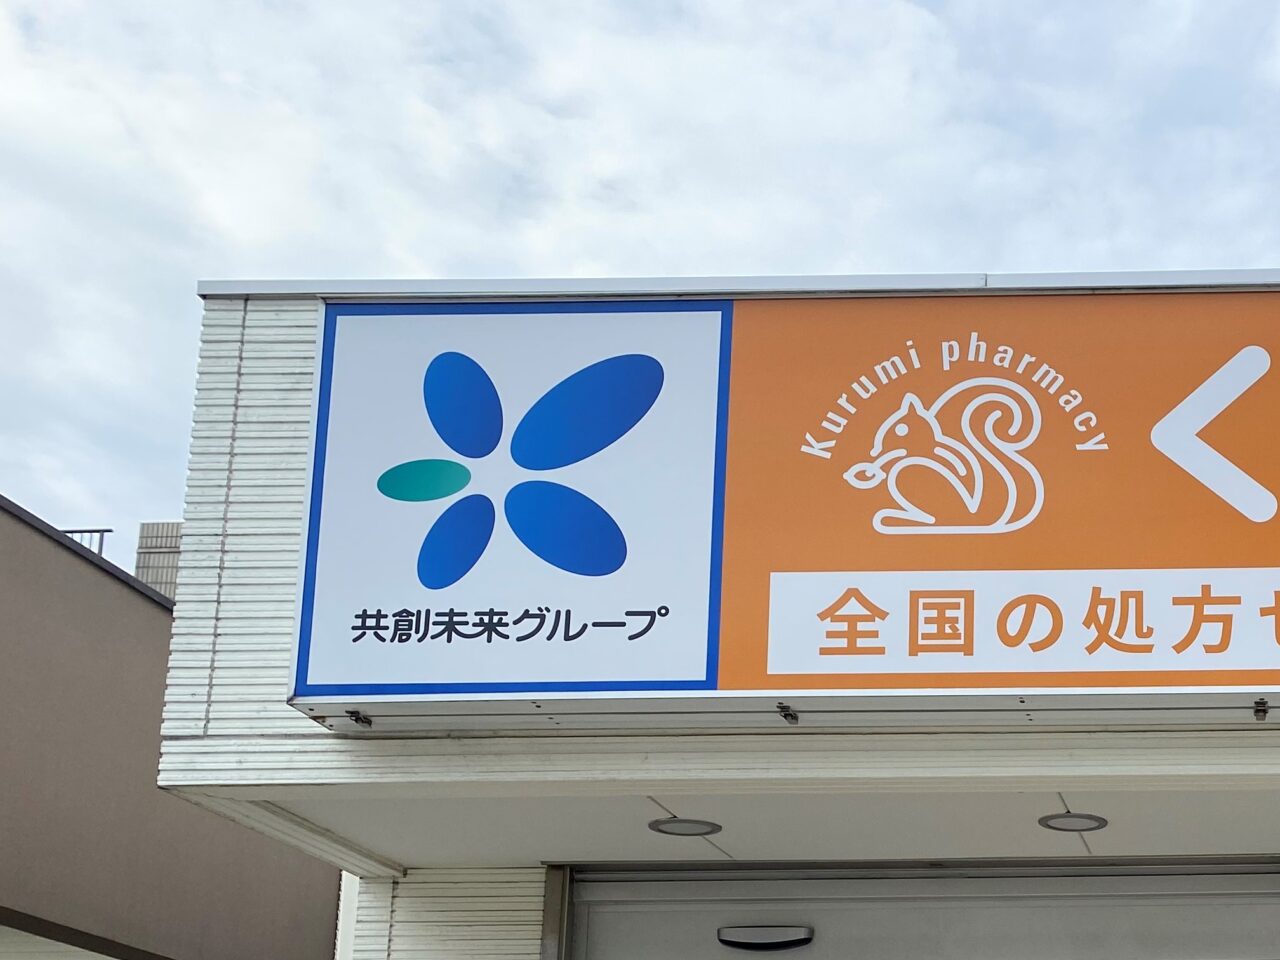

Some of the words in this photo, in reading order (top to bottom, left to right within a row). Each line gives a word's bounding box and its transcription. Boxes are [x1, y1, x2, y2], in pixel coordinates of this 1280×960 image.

[800, 340, 921, 459] Kurumi
[941, 331, 1110, 451] pharmacy
[350, 604, 670, 645] 共創未来グループ
